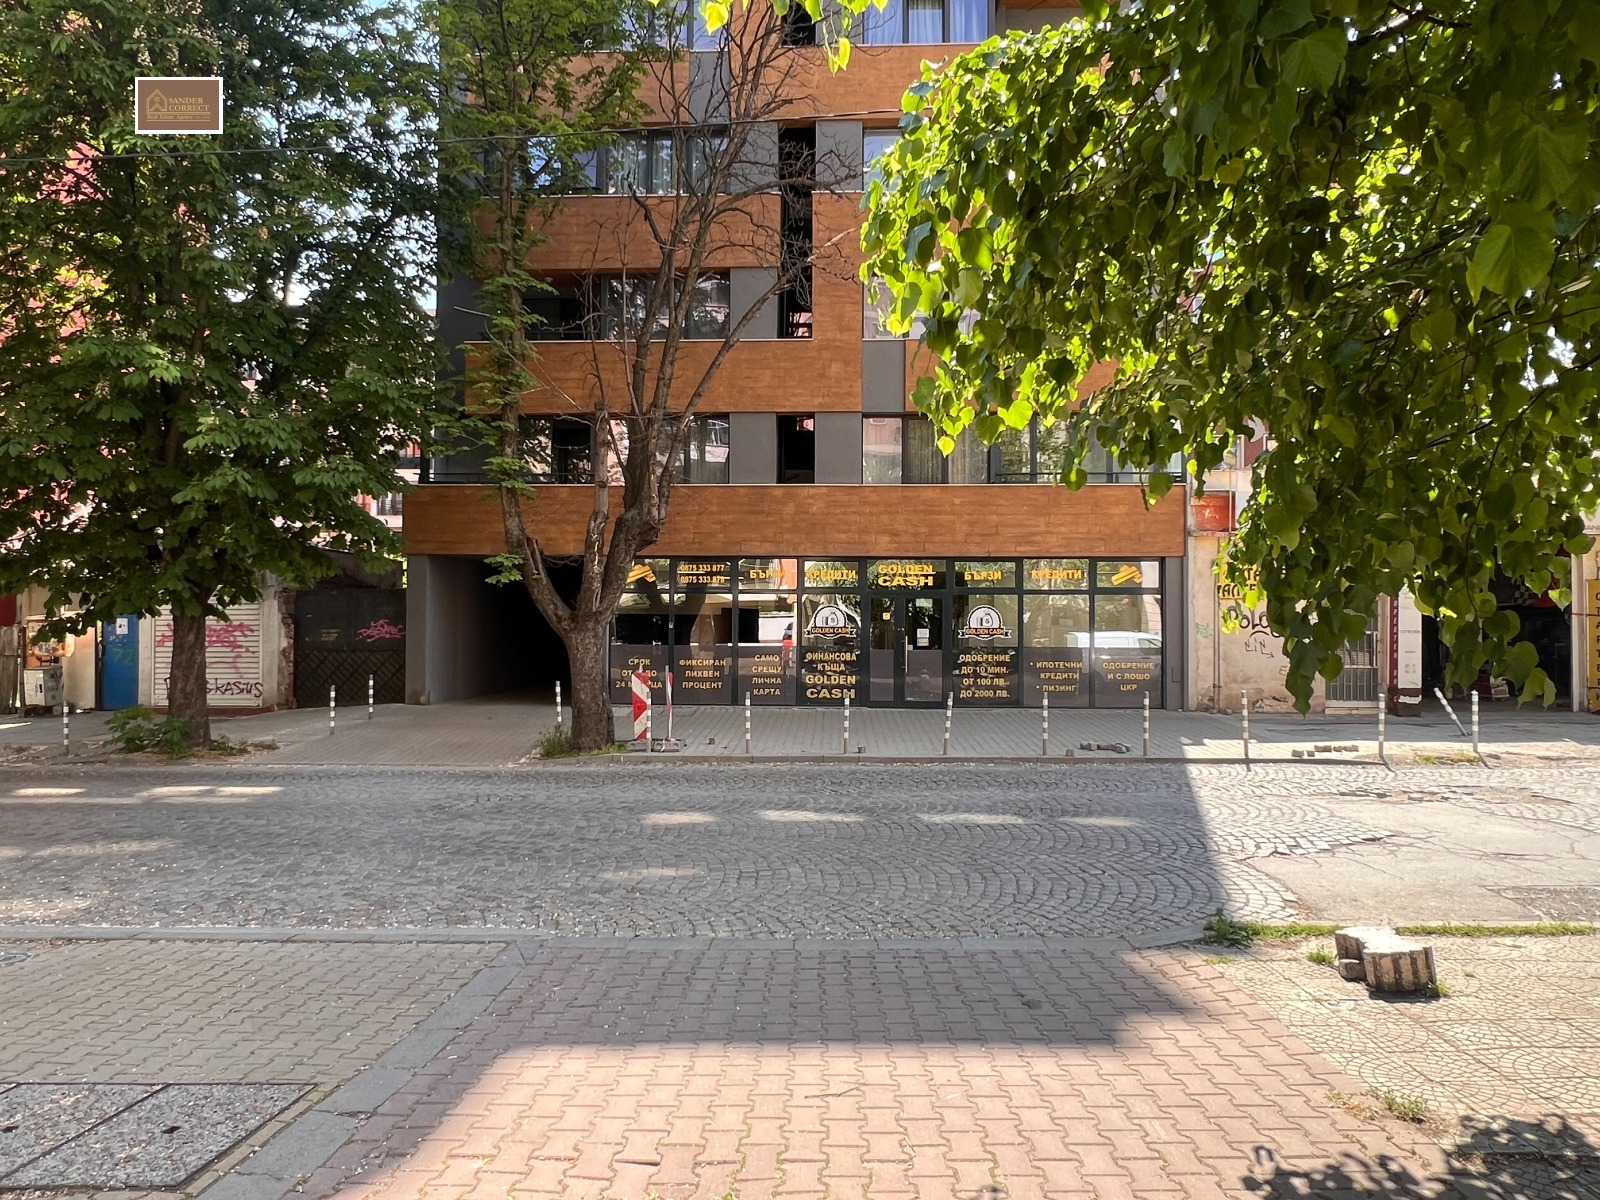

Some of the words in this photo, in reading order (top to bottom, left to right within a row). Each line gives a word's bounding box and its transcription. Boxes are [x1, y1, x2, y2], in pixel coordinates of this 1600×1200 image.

[680, 564, 697, 572] 0875
[698, 564, 711, 572] 333
[712, 564, 725, 572] 877
[877, 564, 933, 575] GOLDEN
[806, 569, 857, 580] КРЕДИТИ
[964, 570, 1002, 581] БЪРЗИ
[1030, 569, 1082, 580] КРЕДИТИ
[877, 576, 934, 587] CASH
[754, 654, 780, 662] САМО
[805, 652, 857, 661] ФИНАНСОВА
[959, 654, 1011, 662] ОДОБРЕНИЕ
[628, 658, 651, 666] СРОК
[1036, 661, 1083, 669] ИПОТЕЧНИ
[1102, 662, 1155, 670] ОДОБРЕНИЕ
[752, 665, 782, 674] СРЕЩУ
[817, 662, 846, 672] КЪЩА
[961, 666, 974, 674] ДО
[975, 666, 986, 674] 10
[987, 666, 1009, 674] МИН.
[685, 670, 720, 678] ЛИХВЕН
[1040, 672, 1080, 680] КРЕДИТИ
[751, 677, 782, 685] ЛИЧНА
[805, 675, 856, 684] GOLDEN
[963, 678, 975, 686] ОТ
[976, 678, 991, 686] 100
[682, 681, 723, 690] ПРОЦЕНТ
[1042, 684, 1077, 692] ЛИЗИНГ
[1120, 683, 1138, 692] ЦКР
[753, 688, 781, 696] КАРТА
[806, 688, 856, 699] CASH
[960, 690, 973, 699] ДО
[974, 690, 994, 698] 2000
[995, 690, 1010, 698] ЛВ.
